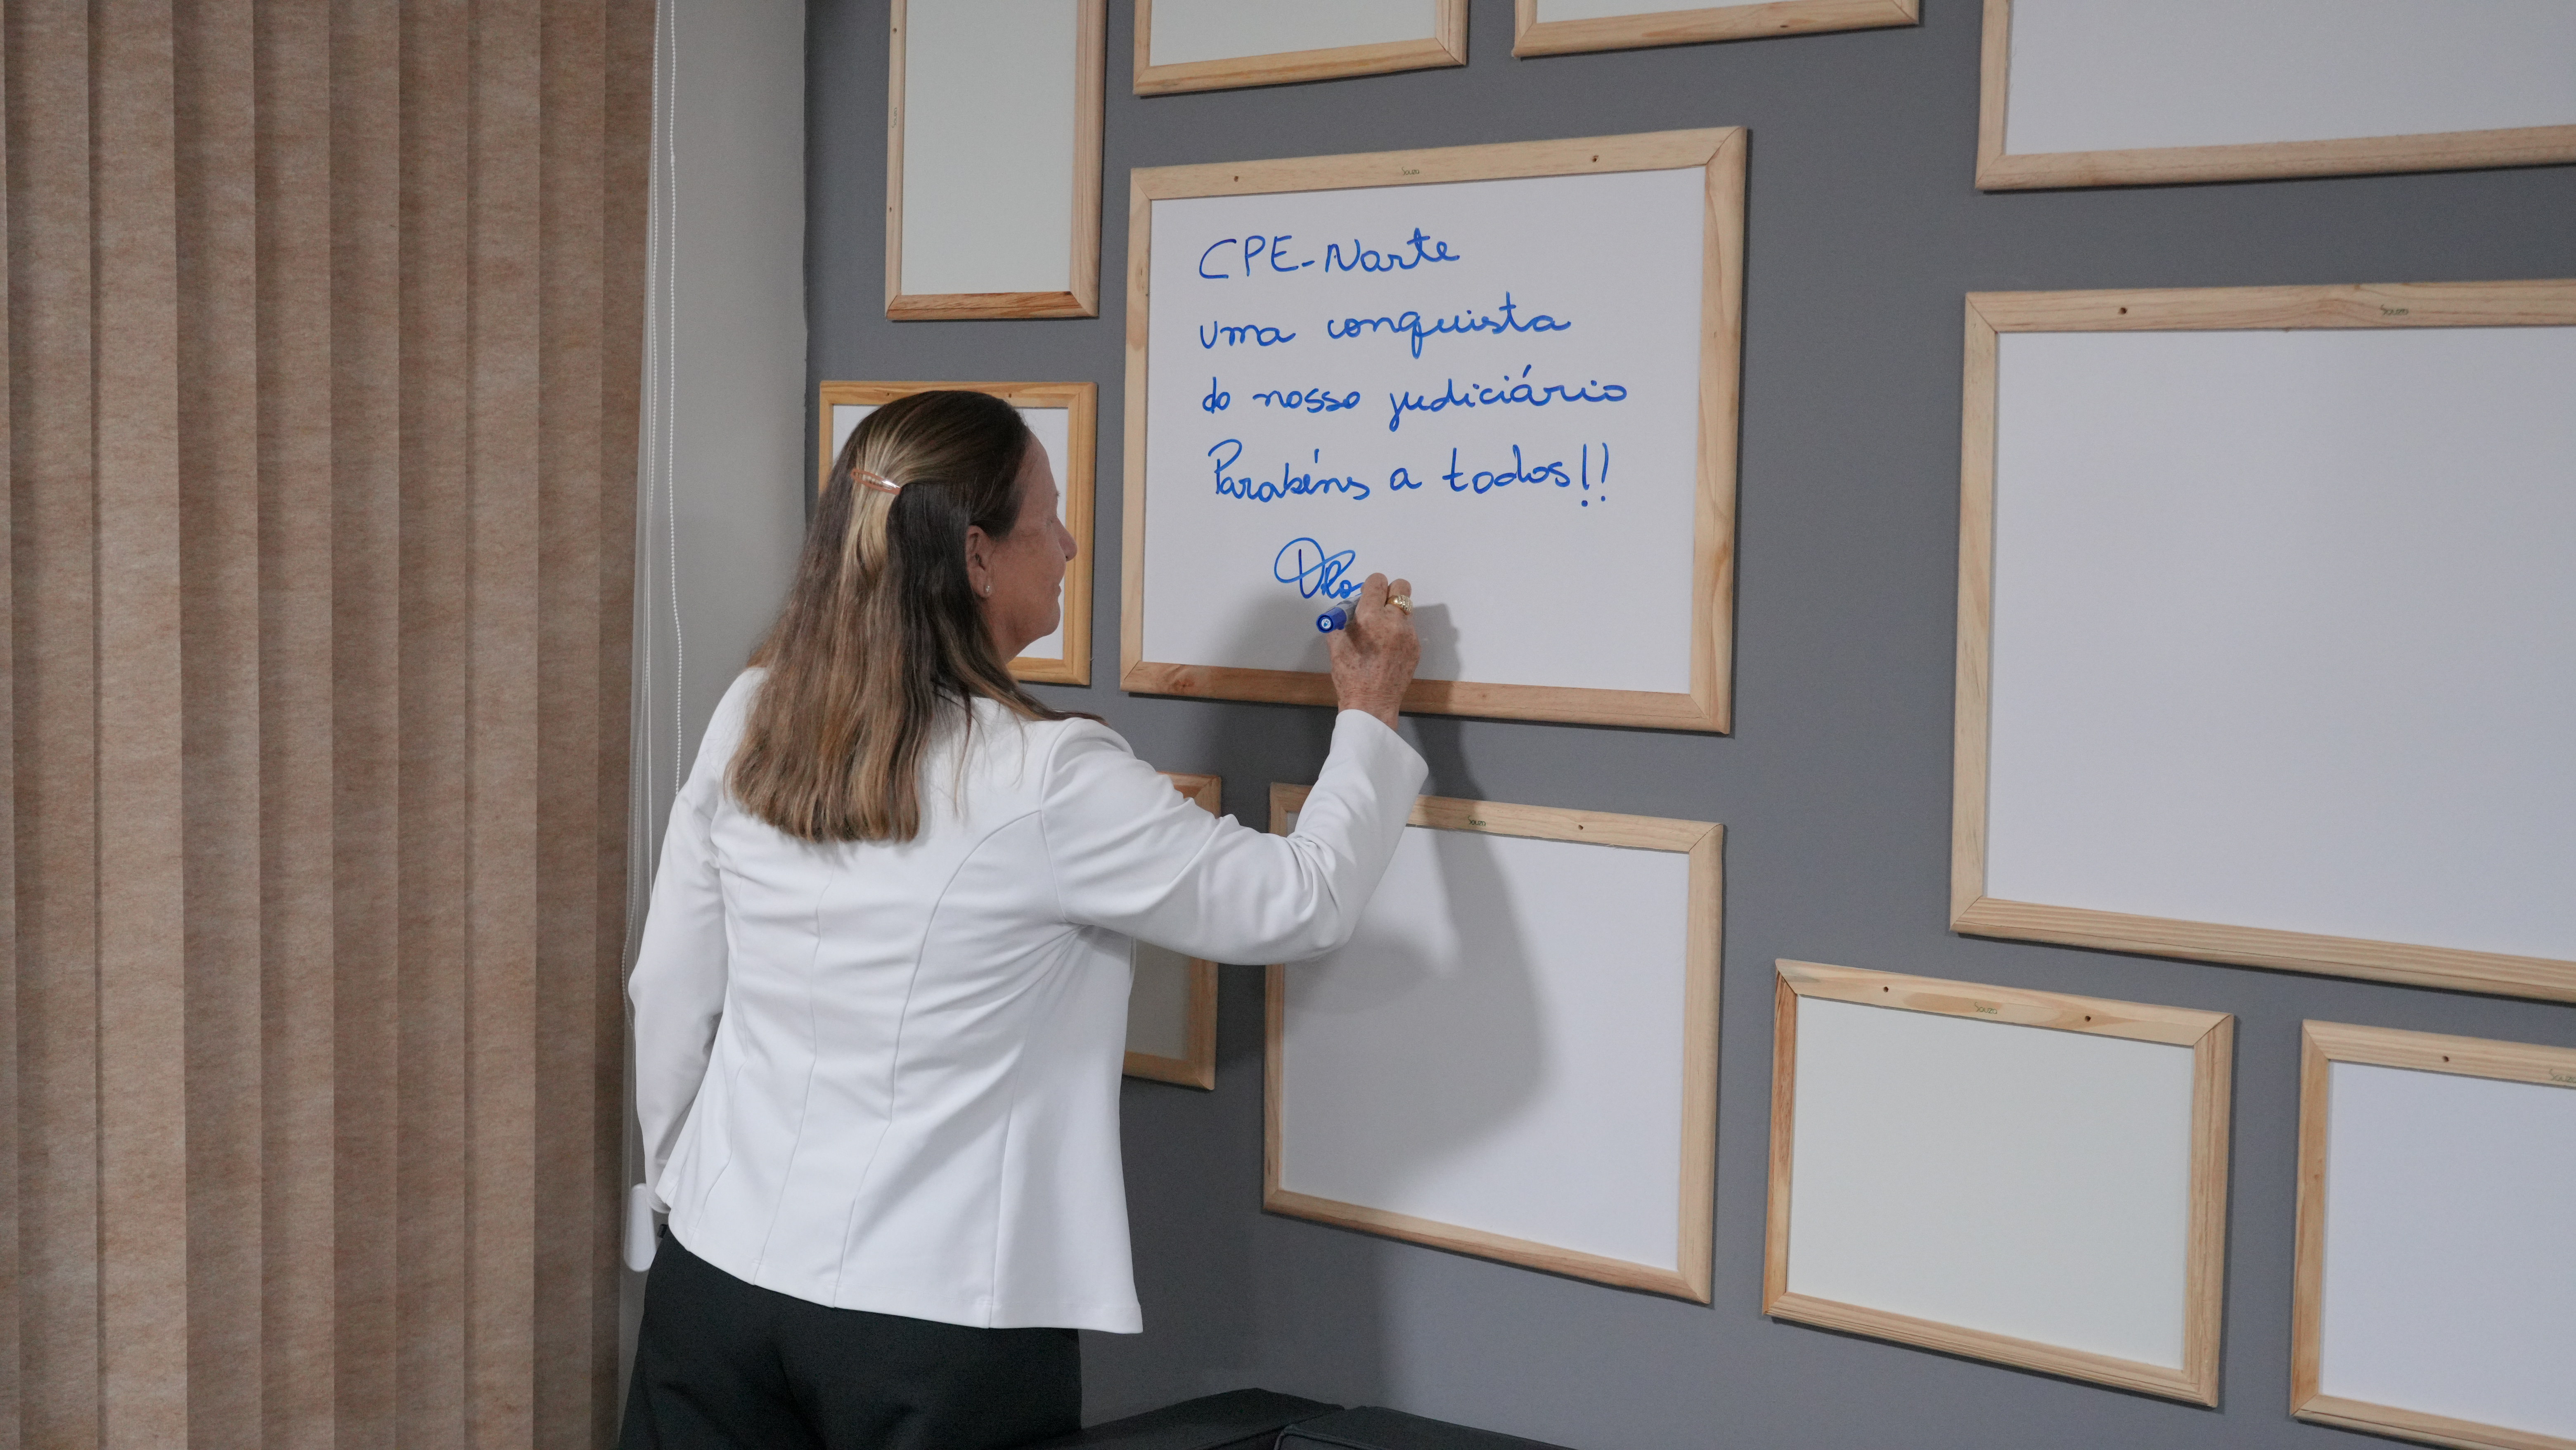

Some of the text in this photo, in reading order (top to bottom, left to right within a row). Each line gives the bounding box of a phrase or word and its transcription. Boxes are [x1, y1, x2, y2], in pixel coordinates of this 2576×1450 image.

[1401, 166, 1420, 175] Souza
[1327, 291, 1572, 359] conquista
[1202, 364, 1627, 433] do nosso judiciário
[1208, 438, 1609, 507] Parabéns a todos!!
[1468, 815, 1486, 827] Souza
[1975, 1002, 1997, 1014] Souza
